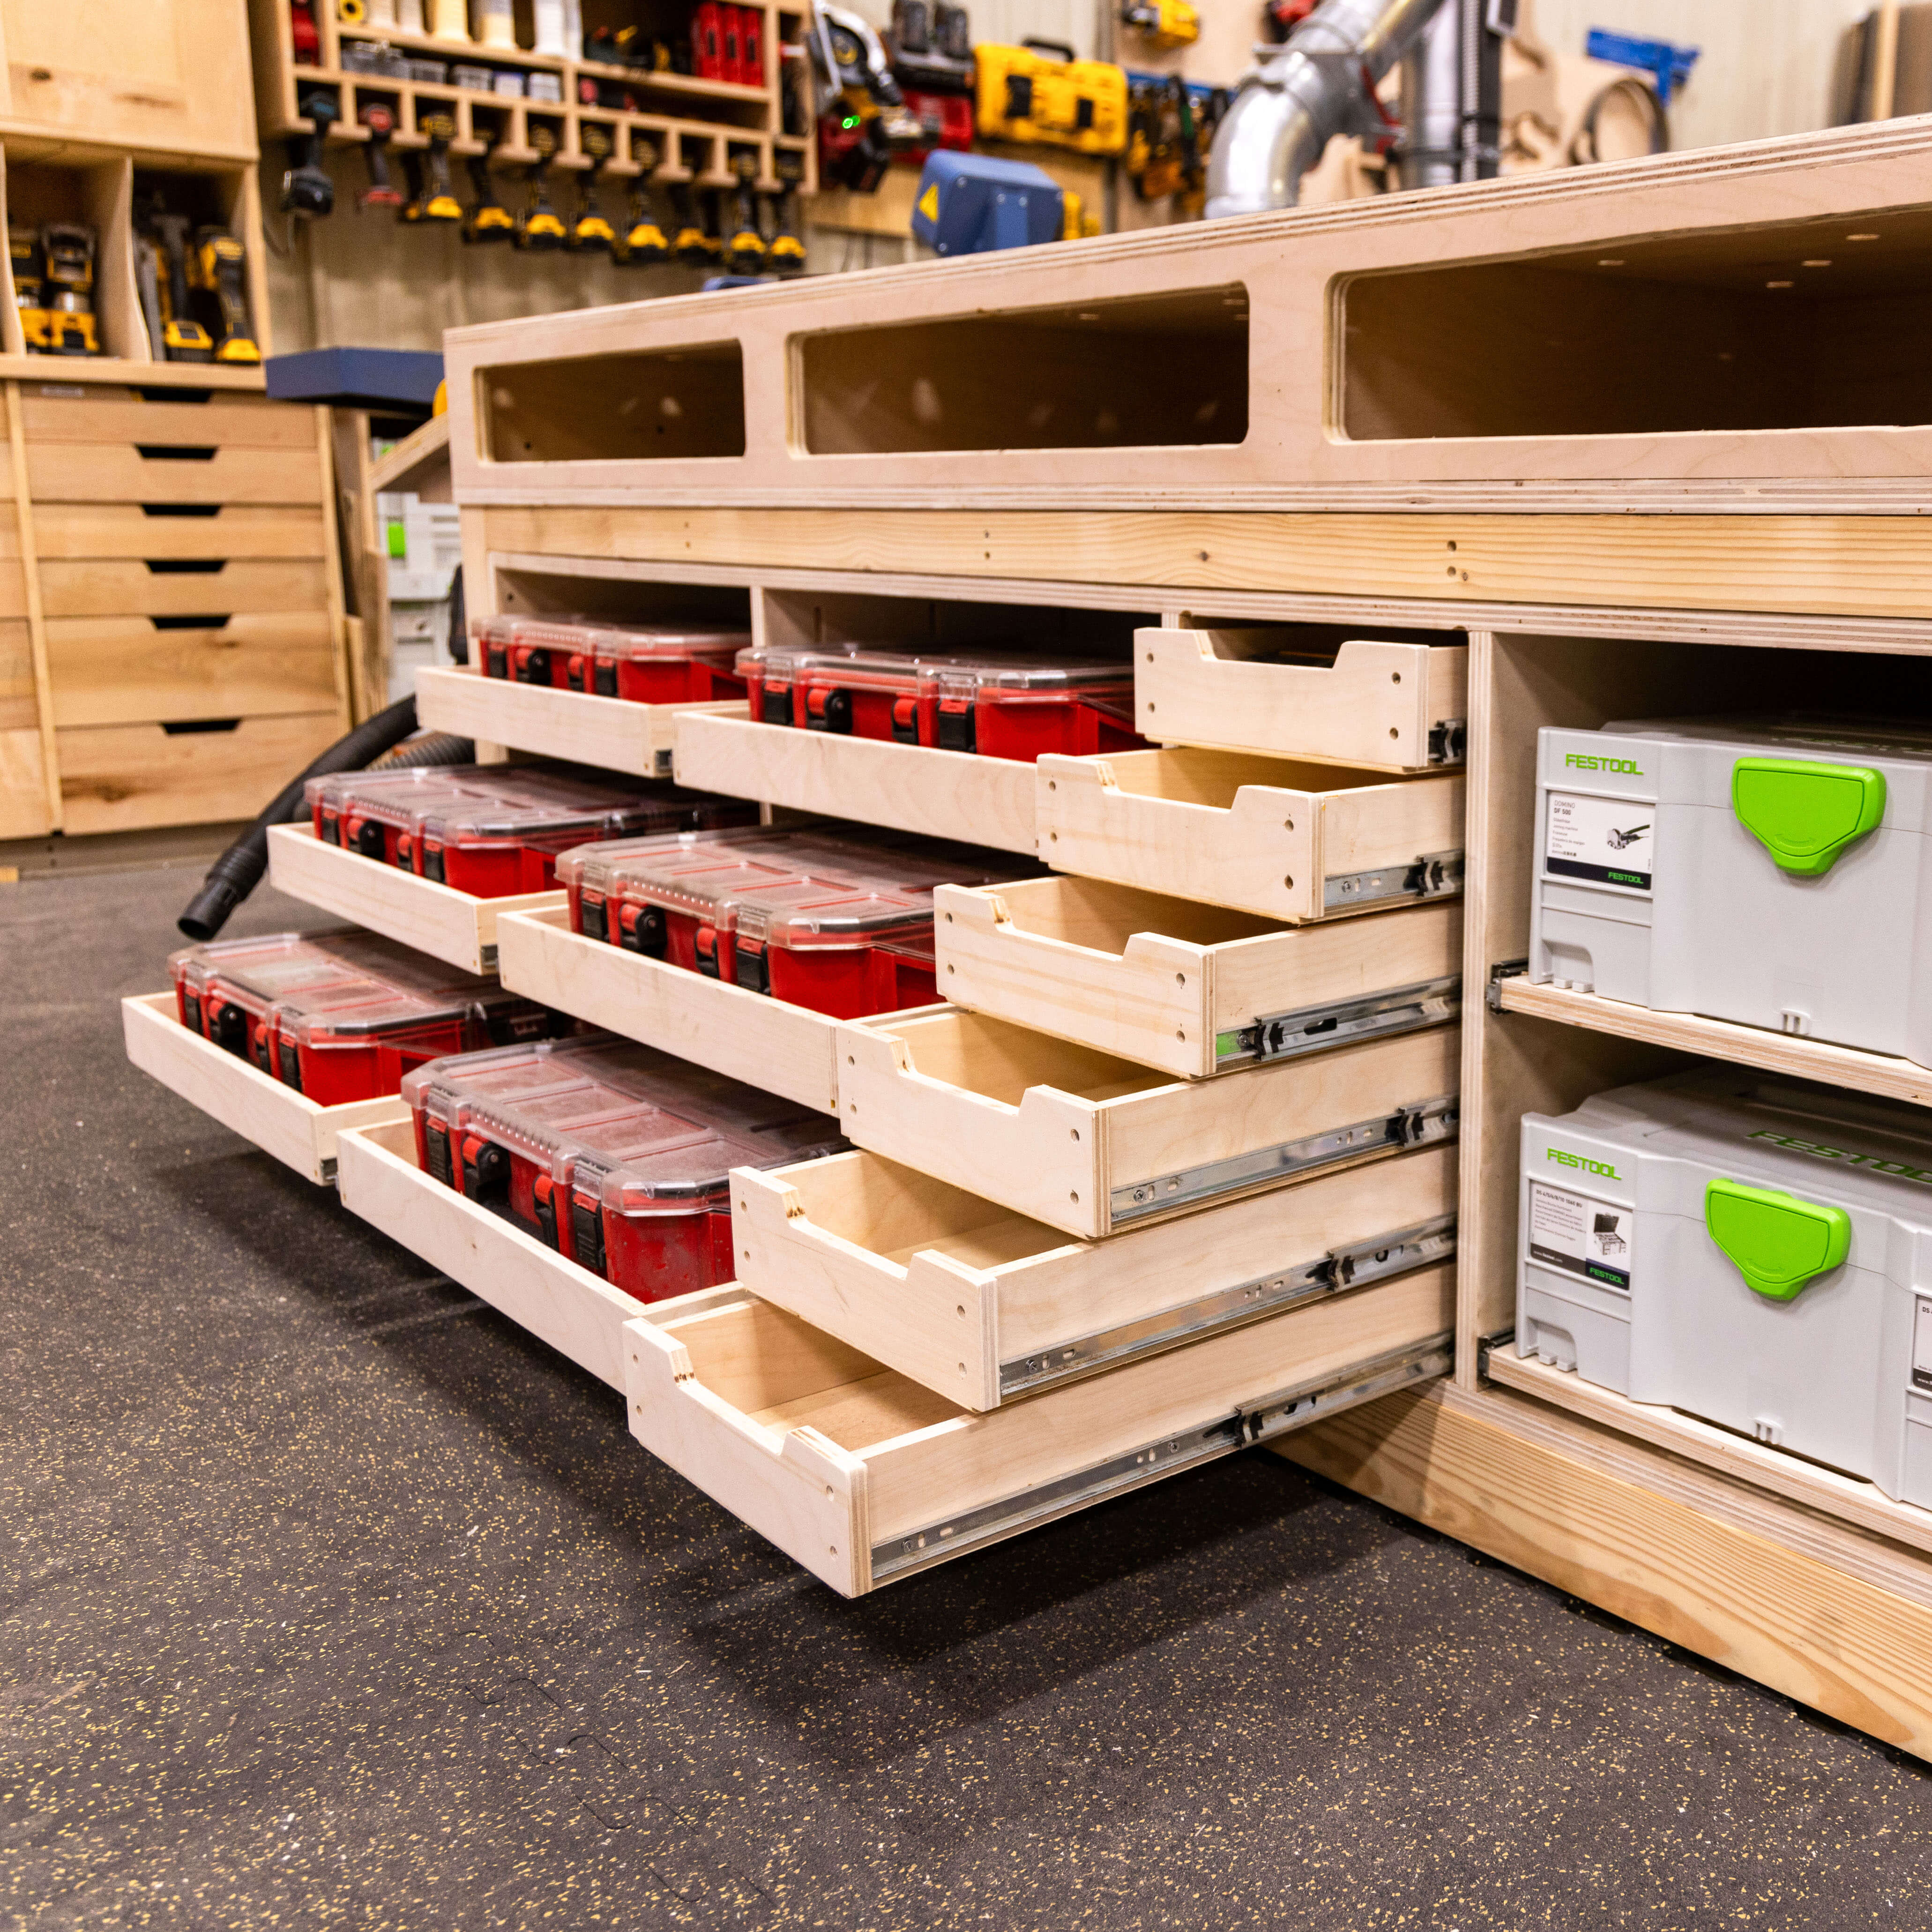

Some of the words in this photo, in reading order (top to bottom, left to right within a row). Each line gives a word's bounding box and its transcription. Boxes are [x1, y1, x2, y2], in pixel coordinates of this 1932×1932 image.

[1566, 753, 1644, 775] FESTOOL
[1554, 800, 1575, 808] DOMINO
[1608, 872, 1644, 884] FESTOOL
[1547, 1148, 1622, 1180] FESTOOL
[1589, 1267, 1625, 1284] FESTOOL
